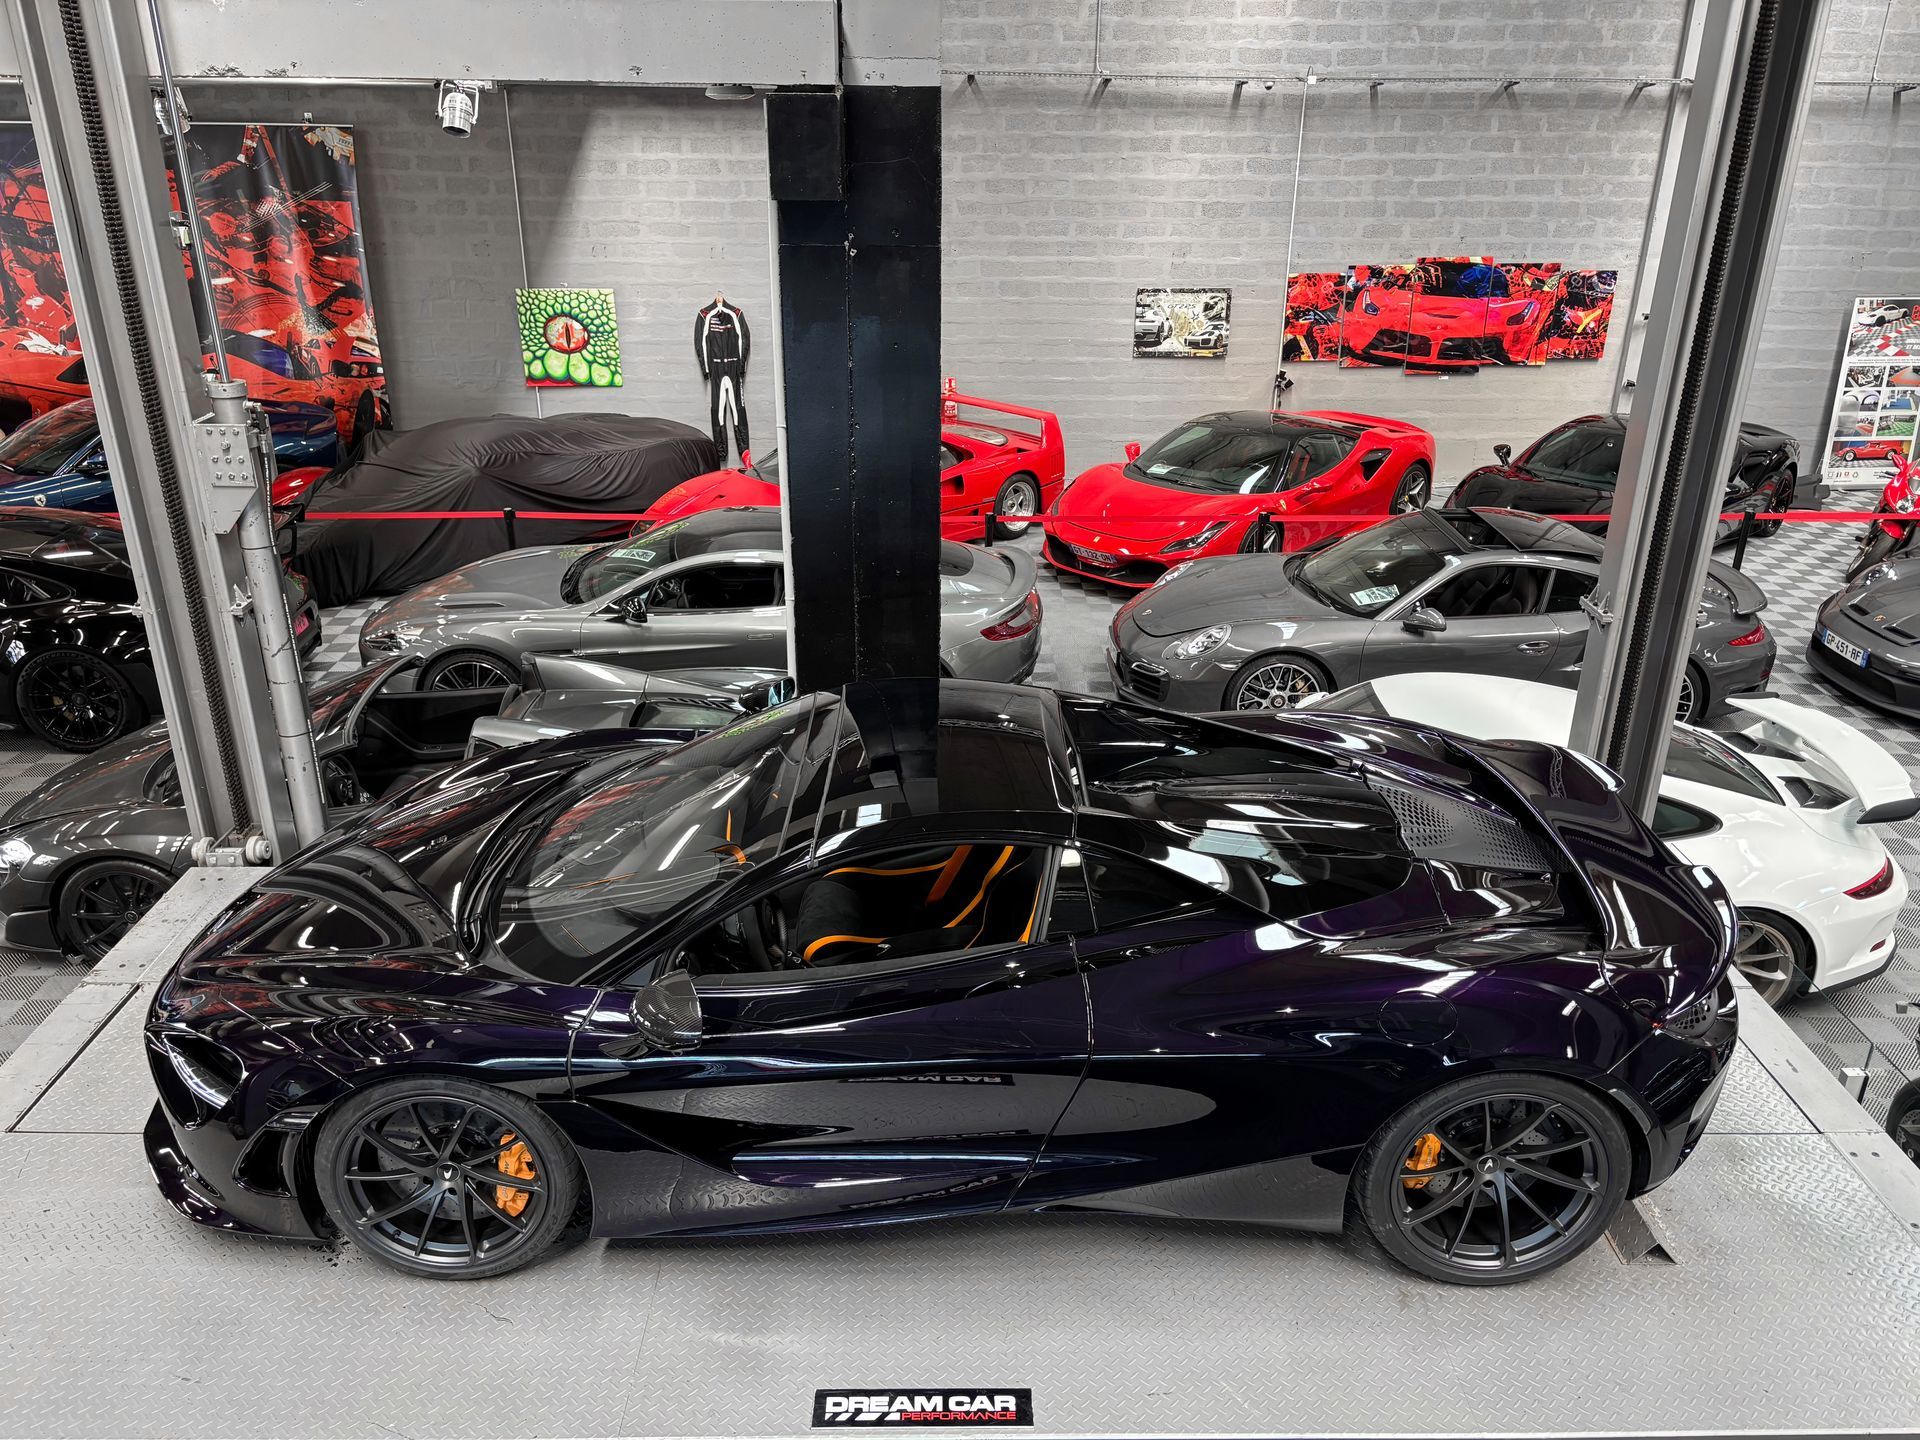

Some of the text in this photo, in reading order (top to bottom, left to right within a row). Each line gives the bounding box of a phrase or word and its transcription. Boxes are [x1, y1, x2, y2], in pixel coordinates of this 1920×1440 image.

[825, 1395, 1016, 1413] DREAM CAR
[901, 1411, 1017, 1421] PERFORMANCE
